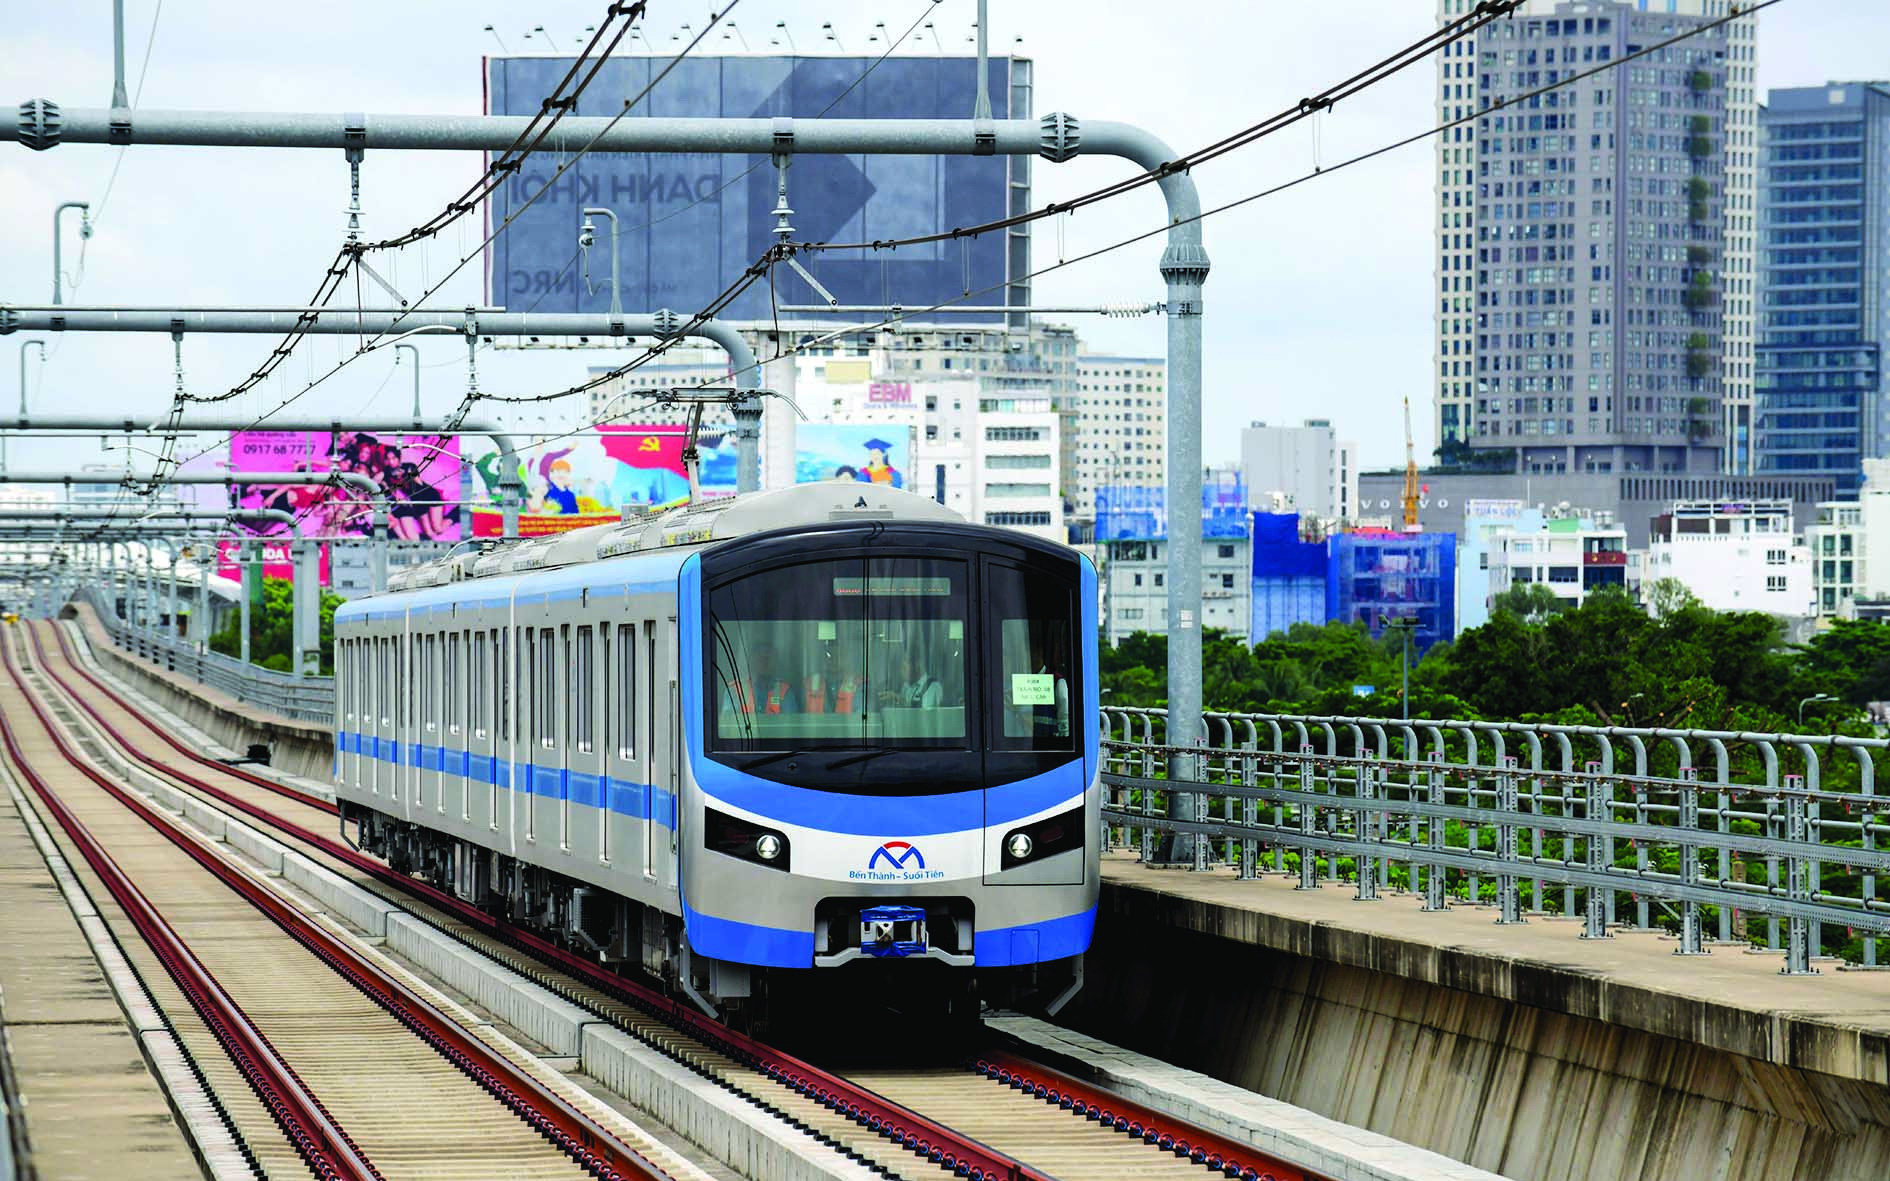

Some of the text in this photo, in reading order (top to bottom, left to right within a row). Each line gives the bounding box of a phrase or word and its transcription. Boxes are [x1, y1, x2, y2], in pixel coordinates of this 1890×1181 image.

[869, 384, 912, 402] EBM
[849, 870, 866, 879] Bến
[868, 871, 895, 880] Thành
[903, 871, 923, 880] Suối
